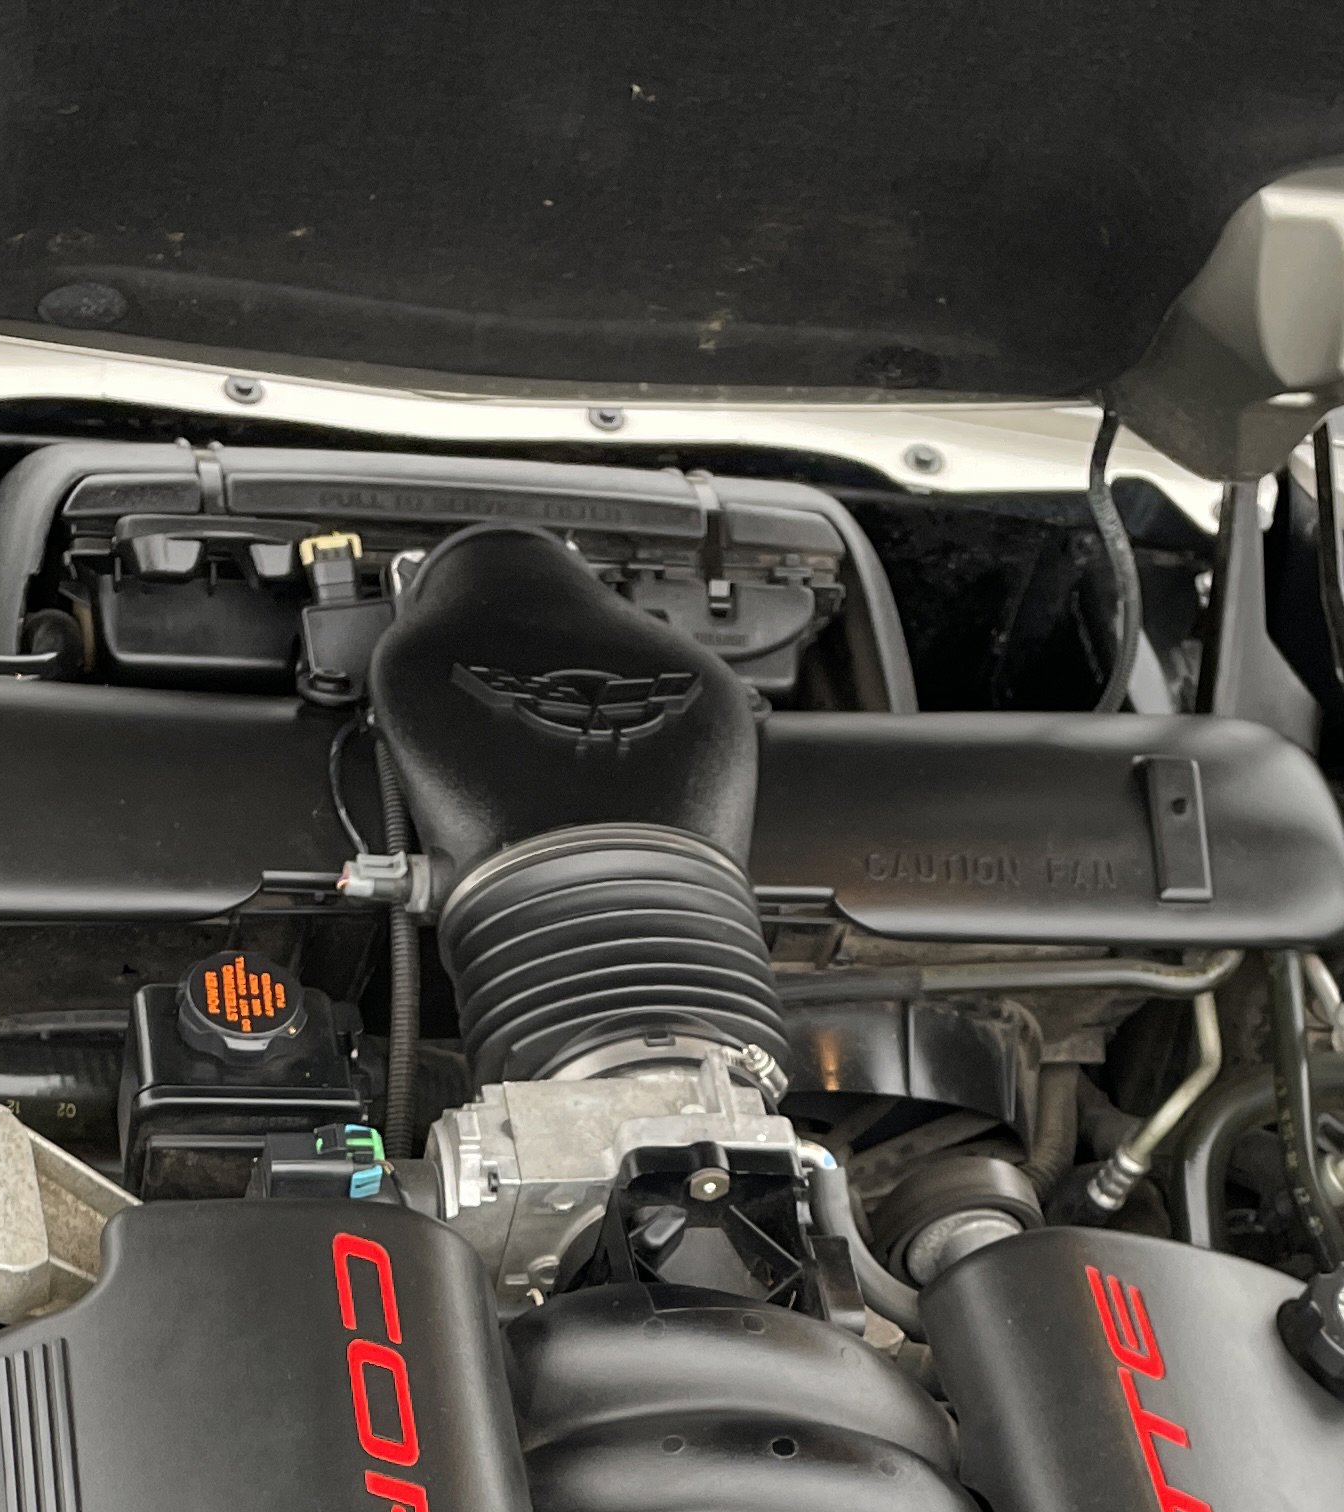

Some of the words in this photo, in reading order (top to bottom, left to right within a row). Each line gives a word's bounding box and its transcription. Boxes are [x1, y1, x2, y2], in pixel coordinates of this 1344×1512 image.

[863, 852, 1022, 888] CAUTION
[1044, 858, 1119, 890] FAN
[205, 971, 220, 1014] POWER
[221, 965, 239, 1022] STEERING
